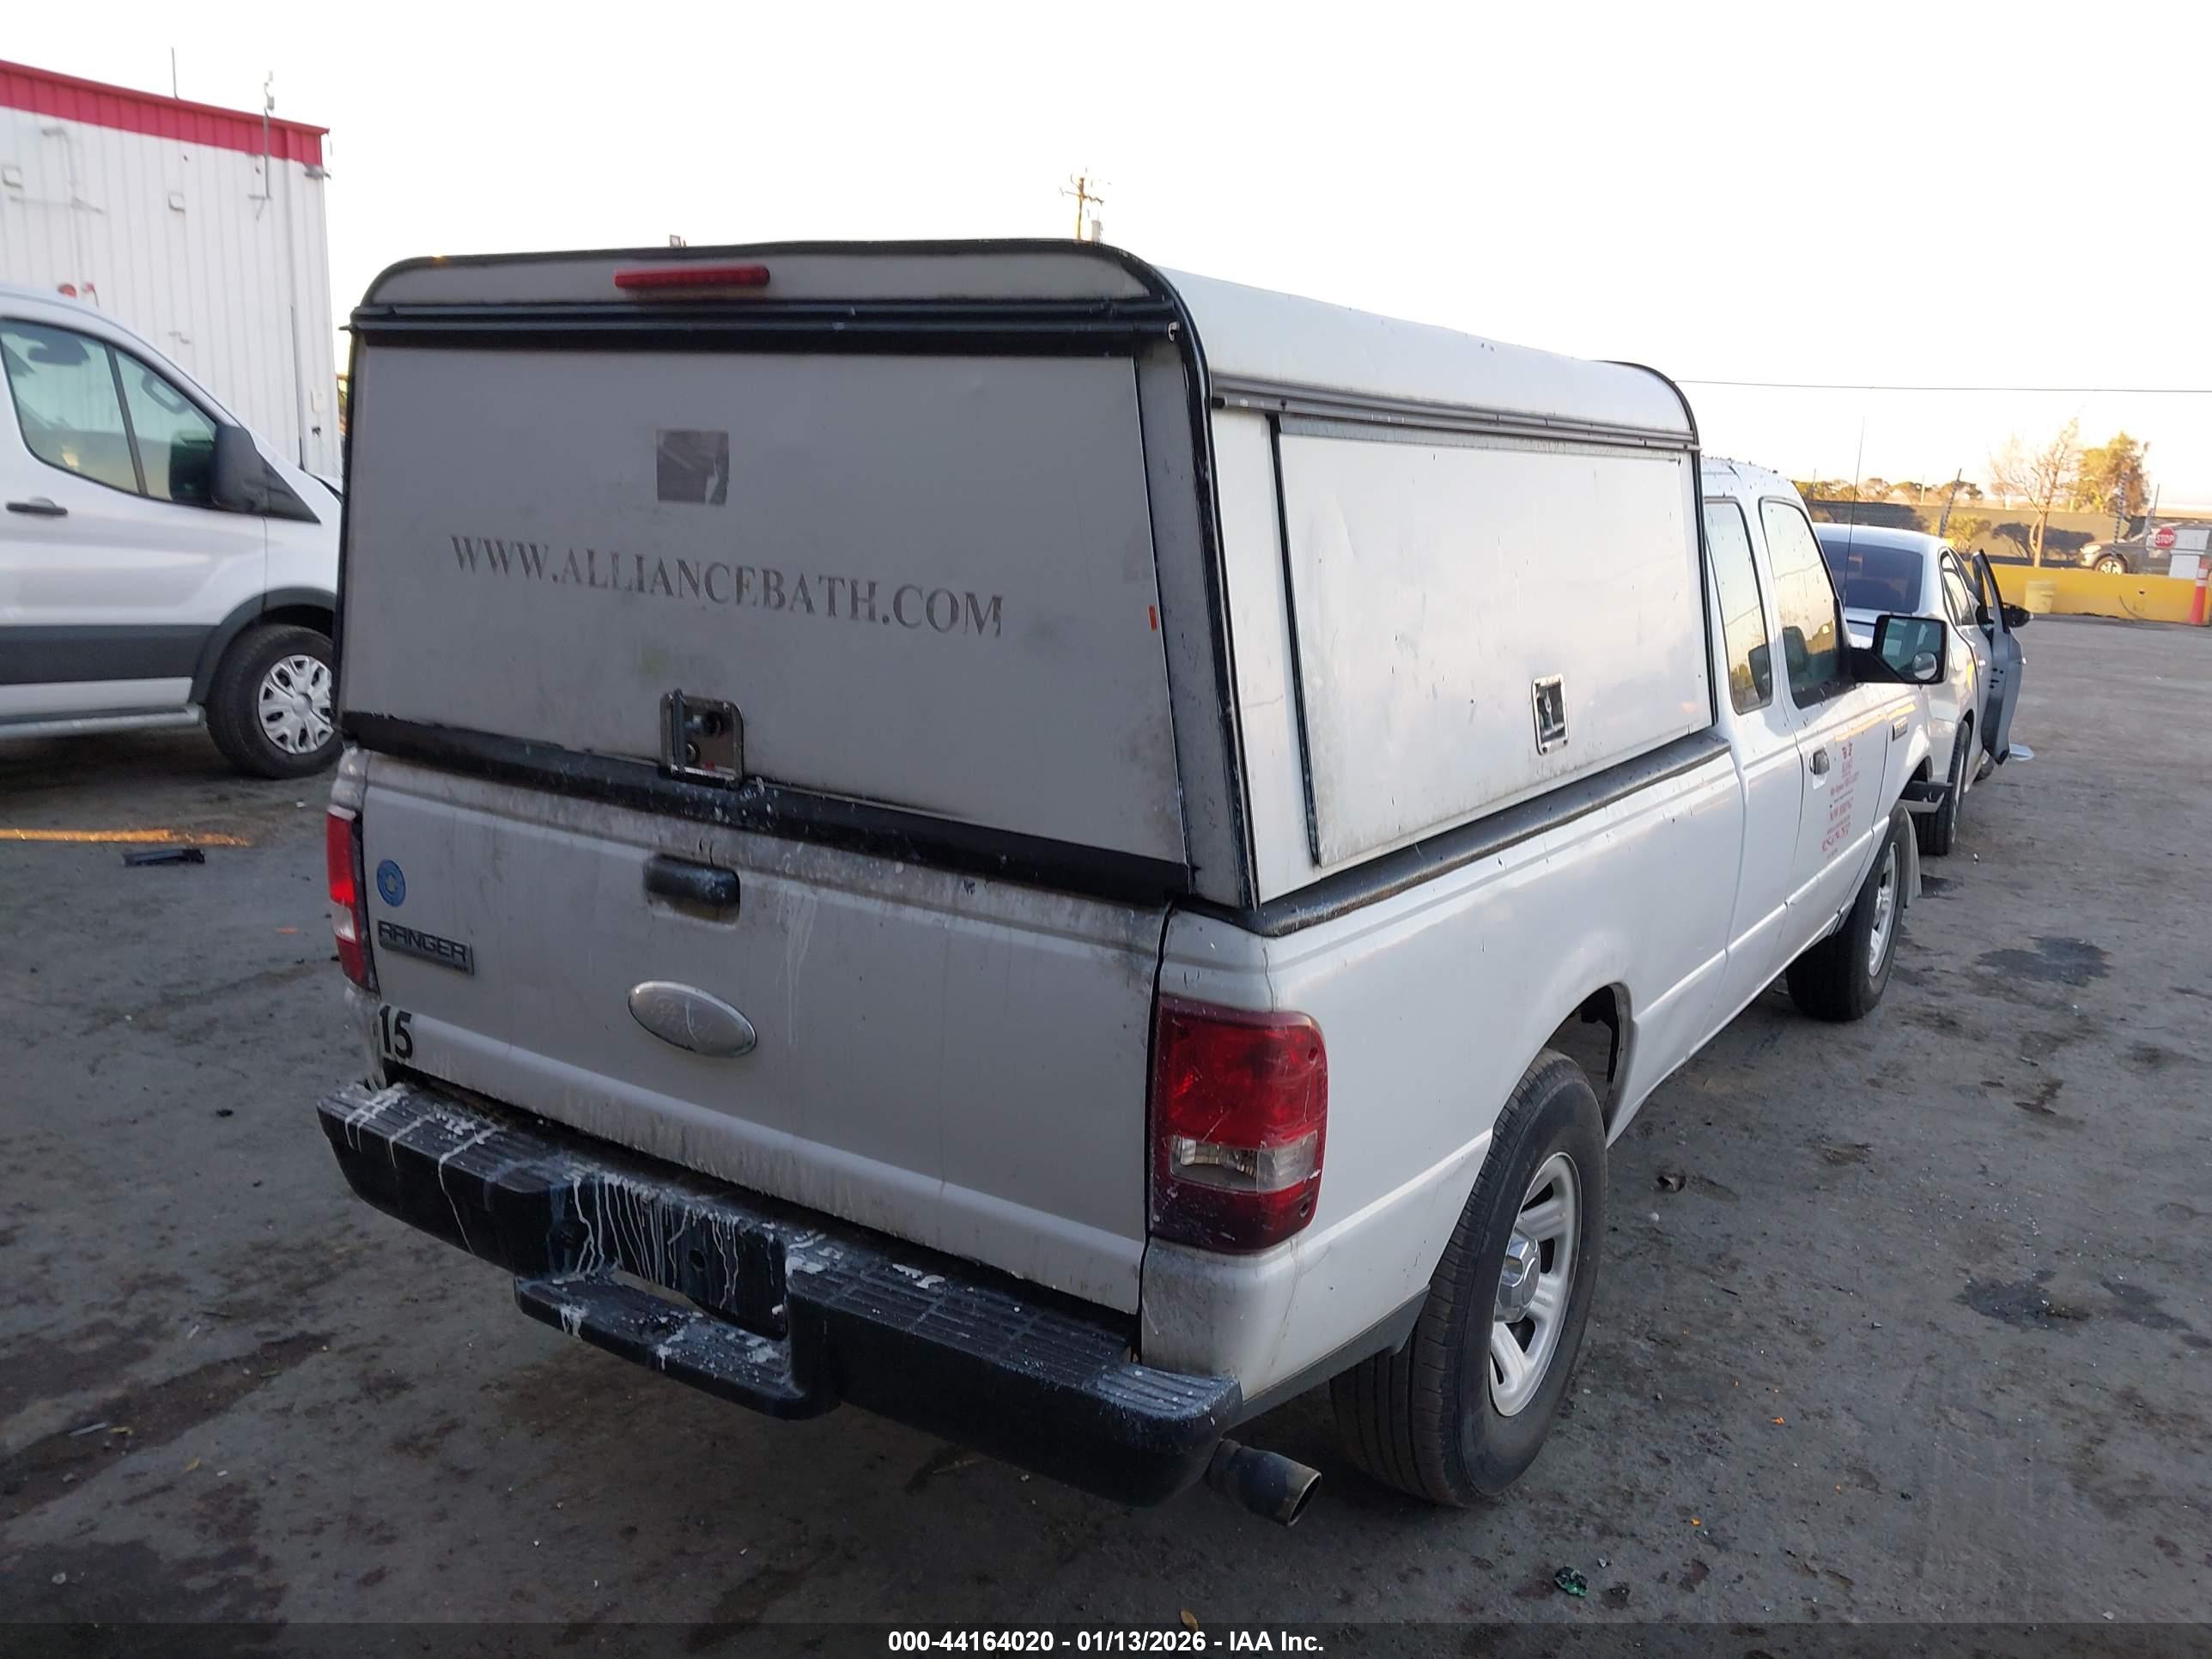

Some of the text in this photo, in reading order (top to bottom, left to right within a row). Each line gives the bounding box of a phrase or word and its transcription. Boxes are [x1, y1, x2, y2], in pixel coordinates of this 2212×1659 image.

[2155, 534, 2174, 544] STOP
[451, 535, 1002, 637] WWW.ALLIANCEBATH.COM
[378, 920, 469, 963] RANGER
[379, 1005, 413, 1060] 15
